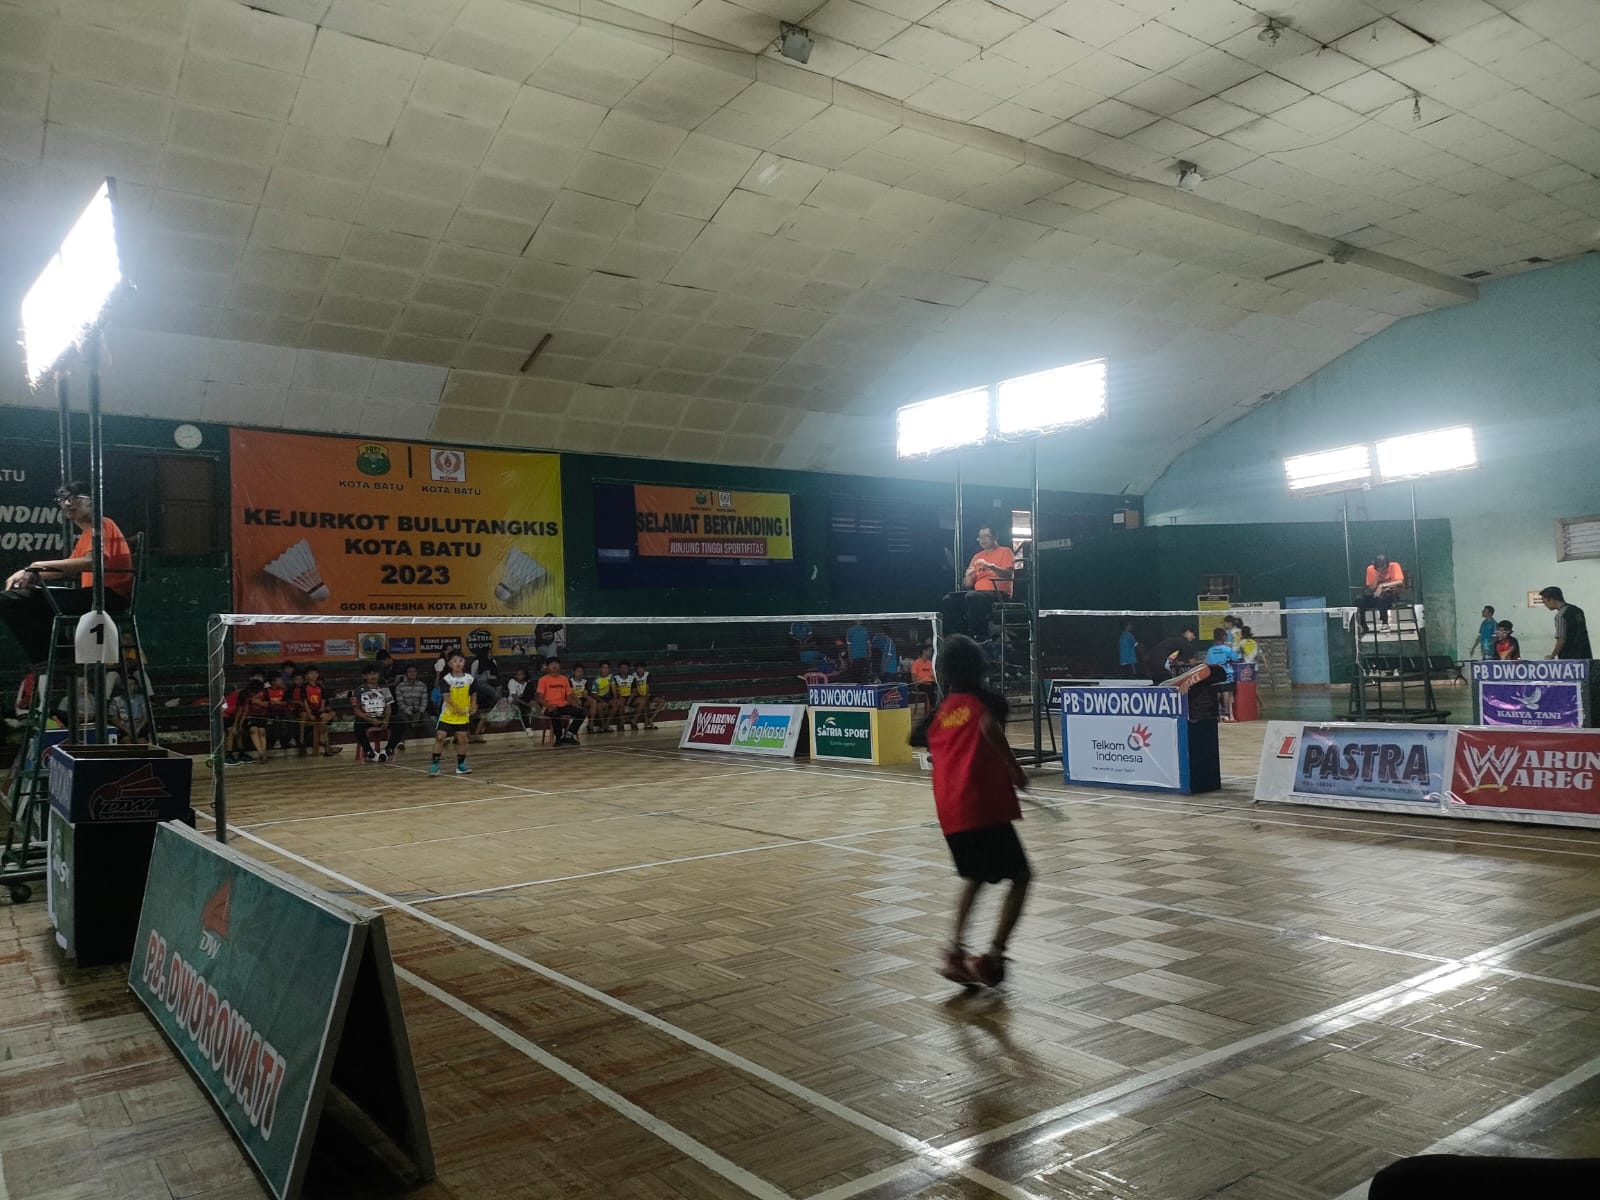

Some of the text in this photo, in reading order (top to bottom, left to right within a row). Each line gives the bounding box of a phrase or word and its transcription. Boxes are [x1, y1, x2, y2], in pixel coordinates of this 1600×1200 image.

[338, 479, 404, 492] KOTA BATU
[421, 484, 481, 496] KOTA BATU
[244, 507, 559, 537] KEJURKOT BULUTANGKIS
[636, 511, 699, 535] SELAMAT
[703, 514, 783, 537] BERTANDING
[344, 538, 482, 558] KOTA BATU
[670, 542, 700, 554] JUNJUNG
[380, 565, 451, 585] 2023
[340, 602, 487, 612] GOR GANESHA KOTA BATU
[89, 624, 105, 645] 1
[1473, 664, 1585, 680] PB DWOROWATI
[809, 688, 819, 705] PB
[820, 688, 875, 706] DWOROWATI
[1063, 692, 1182, 715] PB DWOROWATI
[1496, 710, 1562, 720] KARYA TANI
[737, 718, 785, 743] angkasa
[844, 728, 869, 739] SPORT
[1091, 739, 1125, 751] Telkom
[1096, 751, 1143, 764] Indonesia
[1302, 743, 1430, 786] PASTRA
[200, 929, 223, 959] DW
[165, 951, 287, 1143] DWOROWATI
